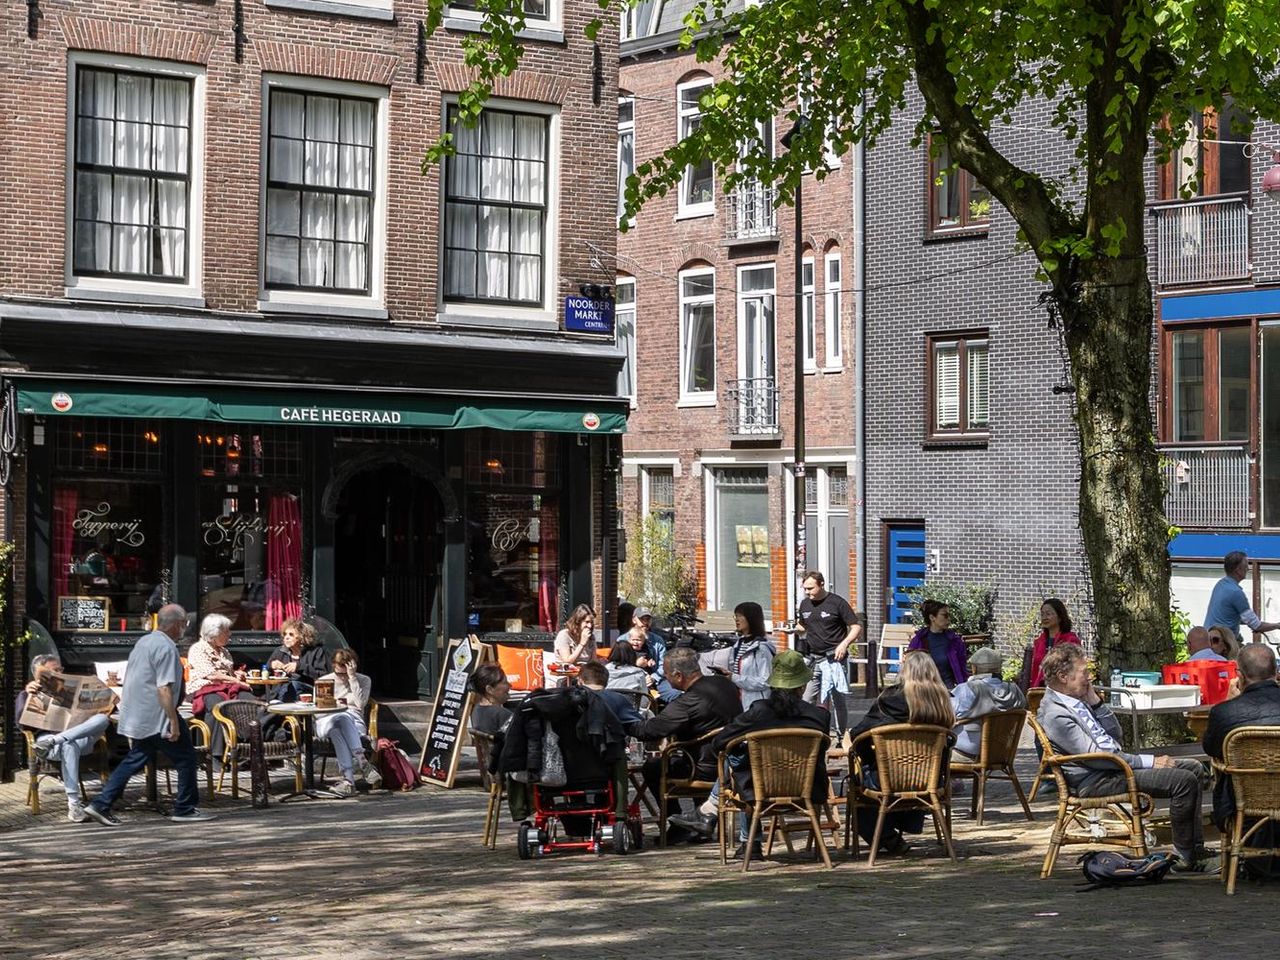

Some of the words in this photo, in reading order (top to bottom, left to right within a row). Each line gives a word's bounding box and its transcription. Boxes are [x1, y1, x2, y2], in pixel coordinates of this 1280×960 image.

[568, 299, 610, 310] NOORDER
[574, 309, 603, 320] MARKT
[281, 405, 319, 421] CAFÉ
[322, 409, 401, 424] HEGERAAD
[72, 501, 145, 547] Tapperij
